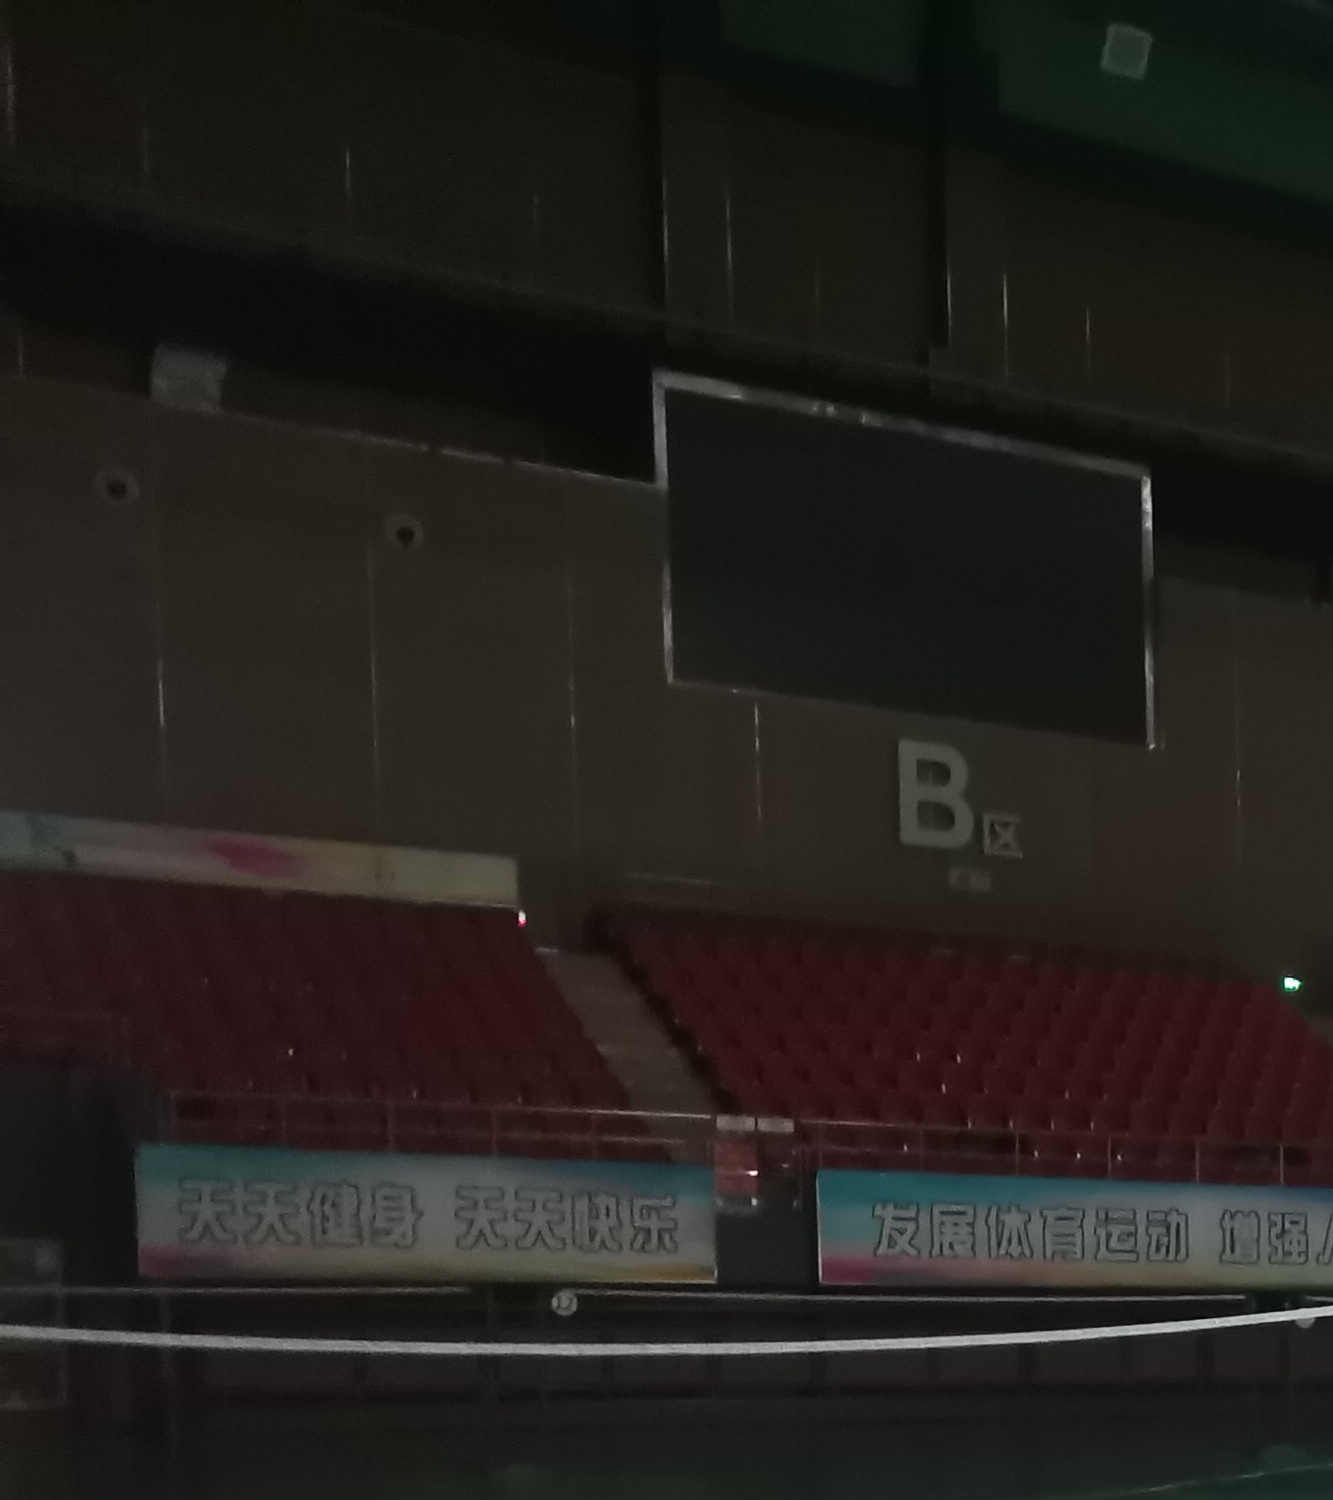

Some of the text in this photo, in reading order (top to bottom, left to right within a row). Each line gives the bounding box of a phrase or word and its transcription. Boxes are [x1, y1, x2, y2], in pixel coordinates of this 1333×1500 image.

[178, 1178, 678, 1253] 天天健身 天天快乐
[872, 1202, 1188, 1262] 发展体育运动
